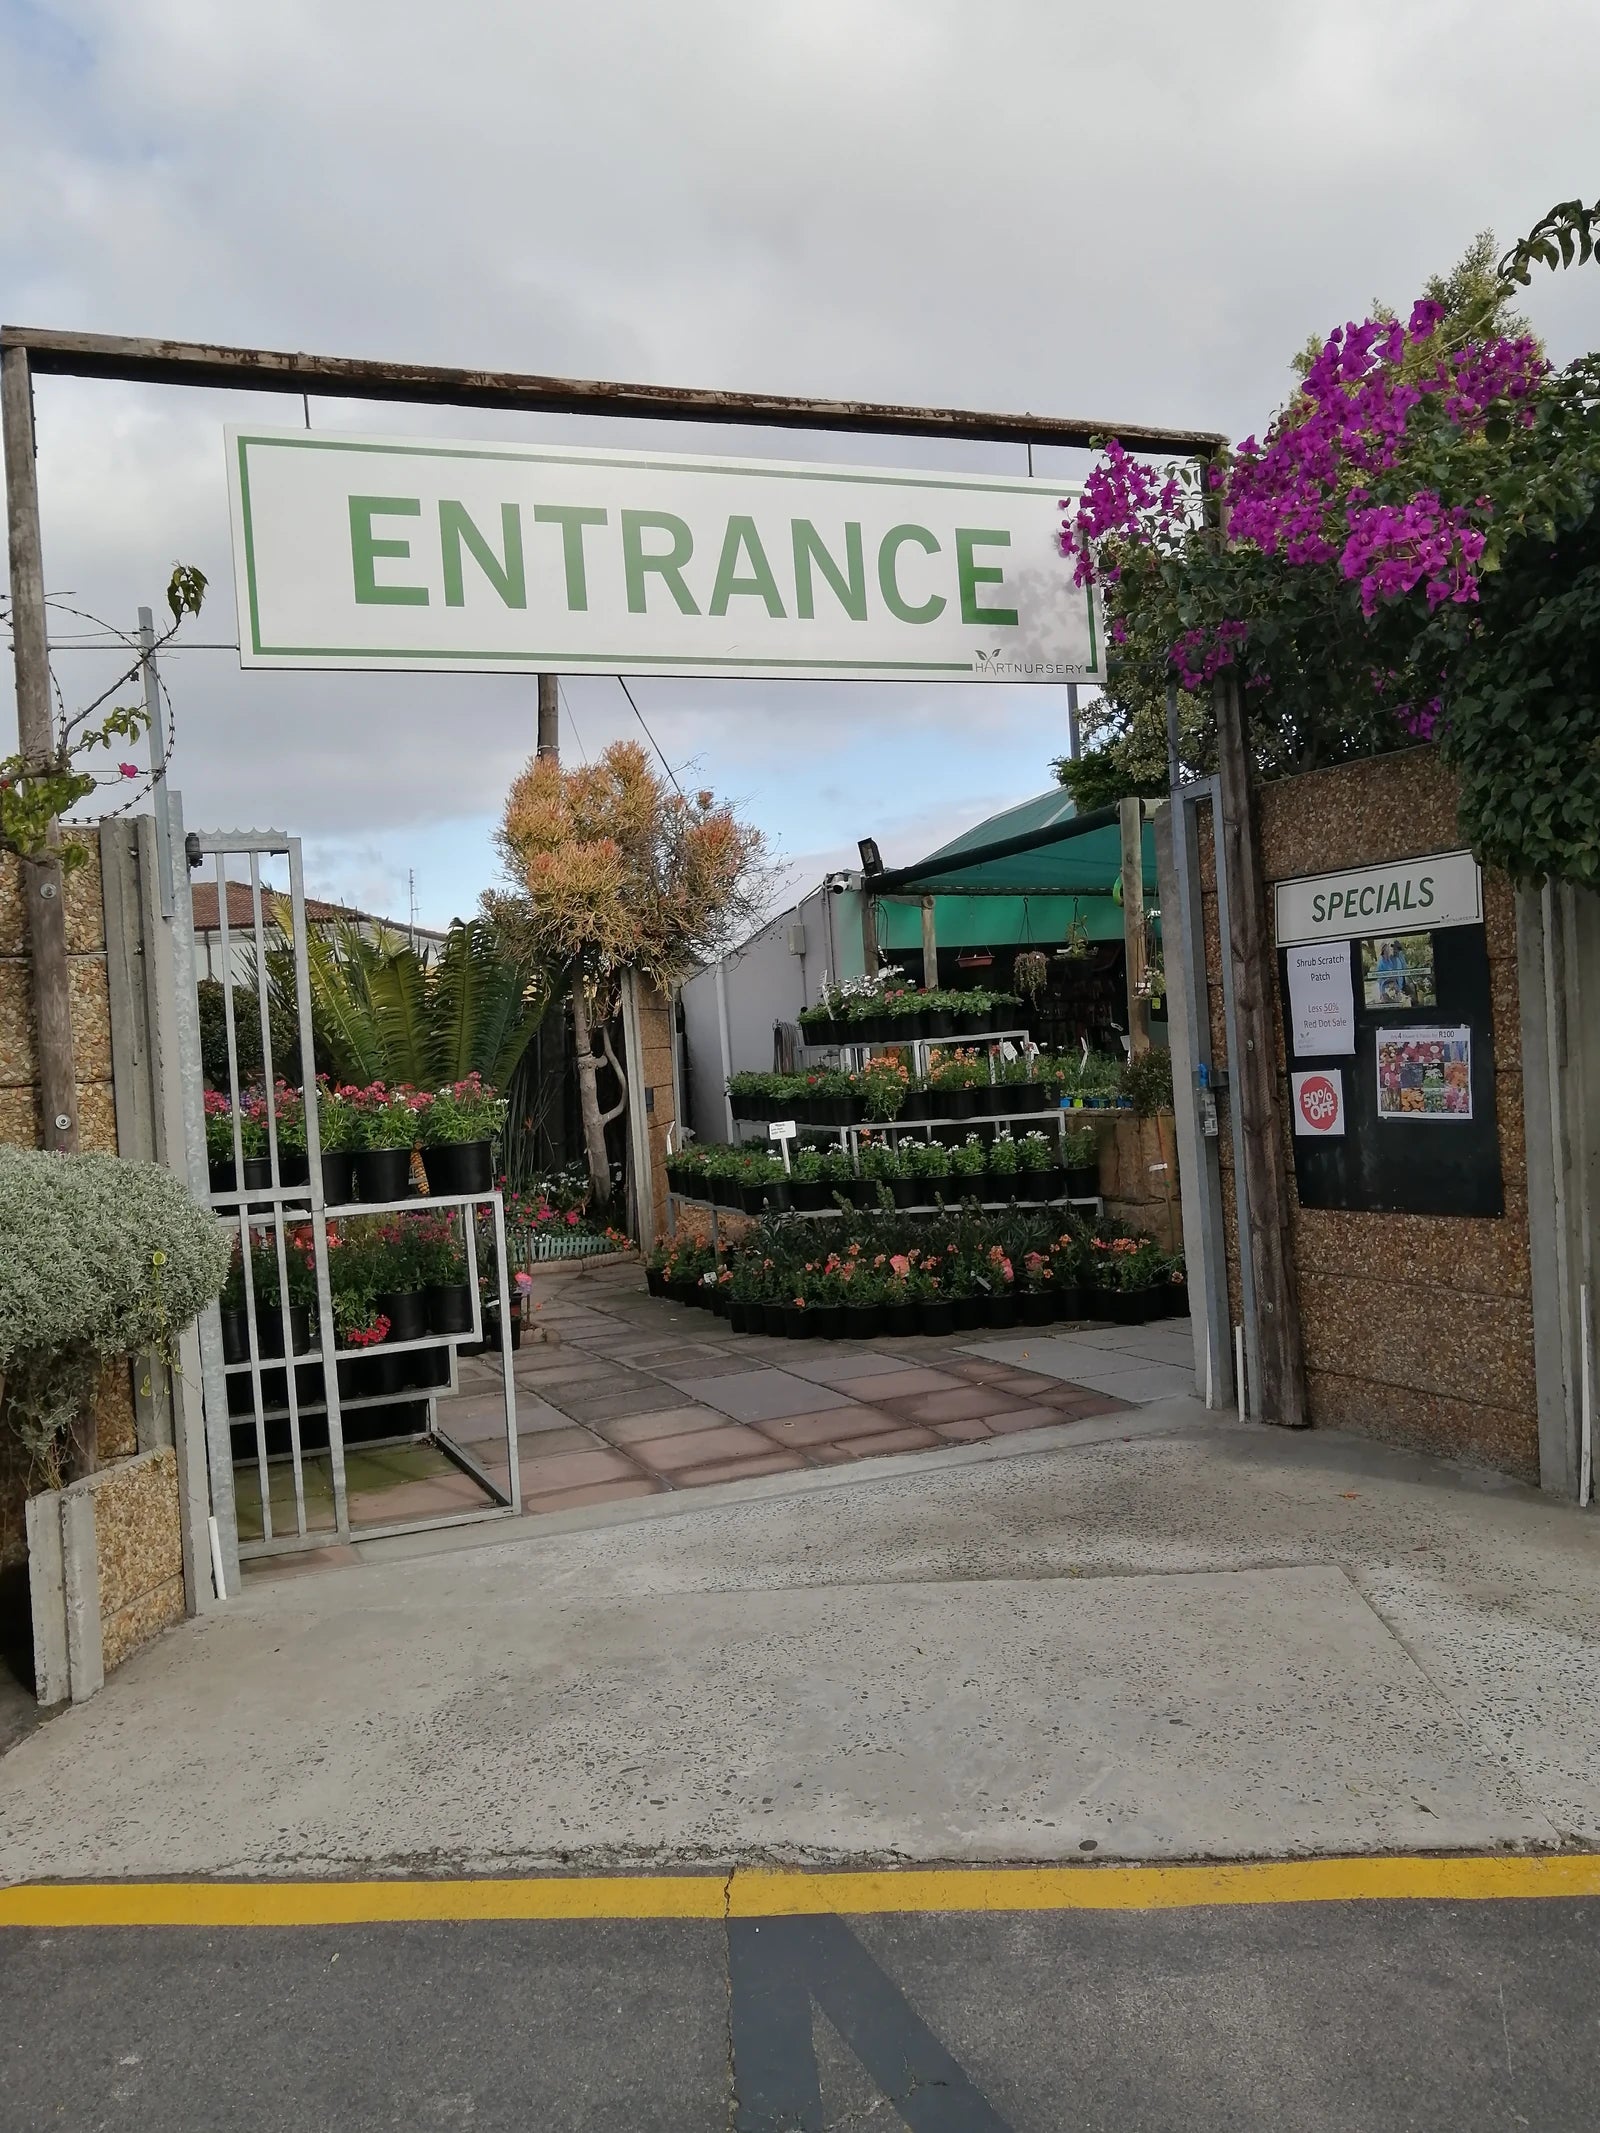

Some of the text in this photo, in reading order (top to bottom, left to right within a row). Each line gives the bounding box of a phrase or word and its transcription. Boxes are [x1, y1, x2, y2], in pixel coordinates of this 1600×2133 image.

[348, 494, 1019, 626] ENTRANCE
[1312, 876, 1434, 922] SPECIALS
[1296, 953, 1345, 968] Shrub Scratch
[1310, 971, 1331, 982] Patch
[1308, 1002, 1340, 1013] Less 50%
[1303, 1017, 1347, 1029] Red Dot Sale
[1438, 1030, 1455, 1038] R100
[1303, 1087, 1333, 1109] 50%
[1310, 1101, 1335, 1120] OFF
